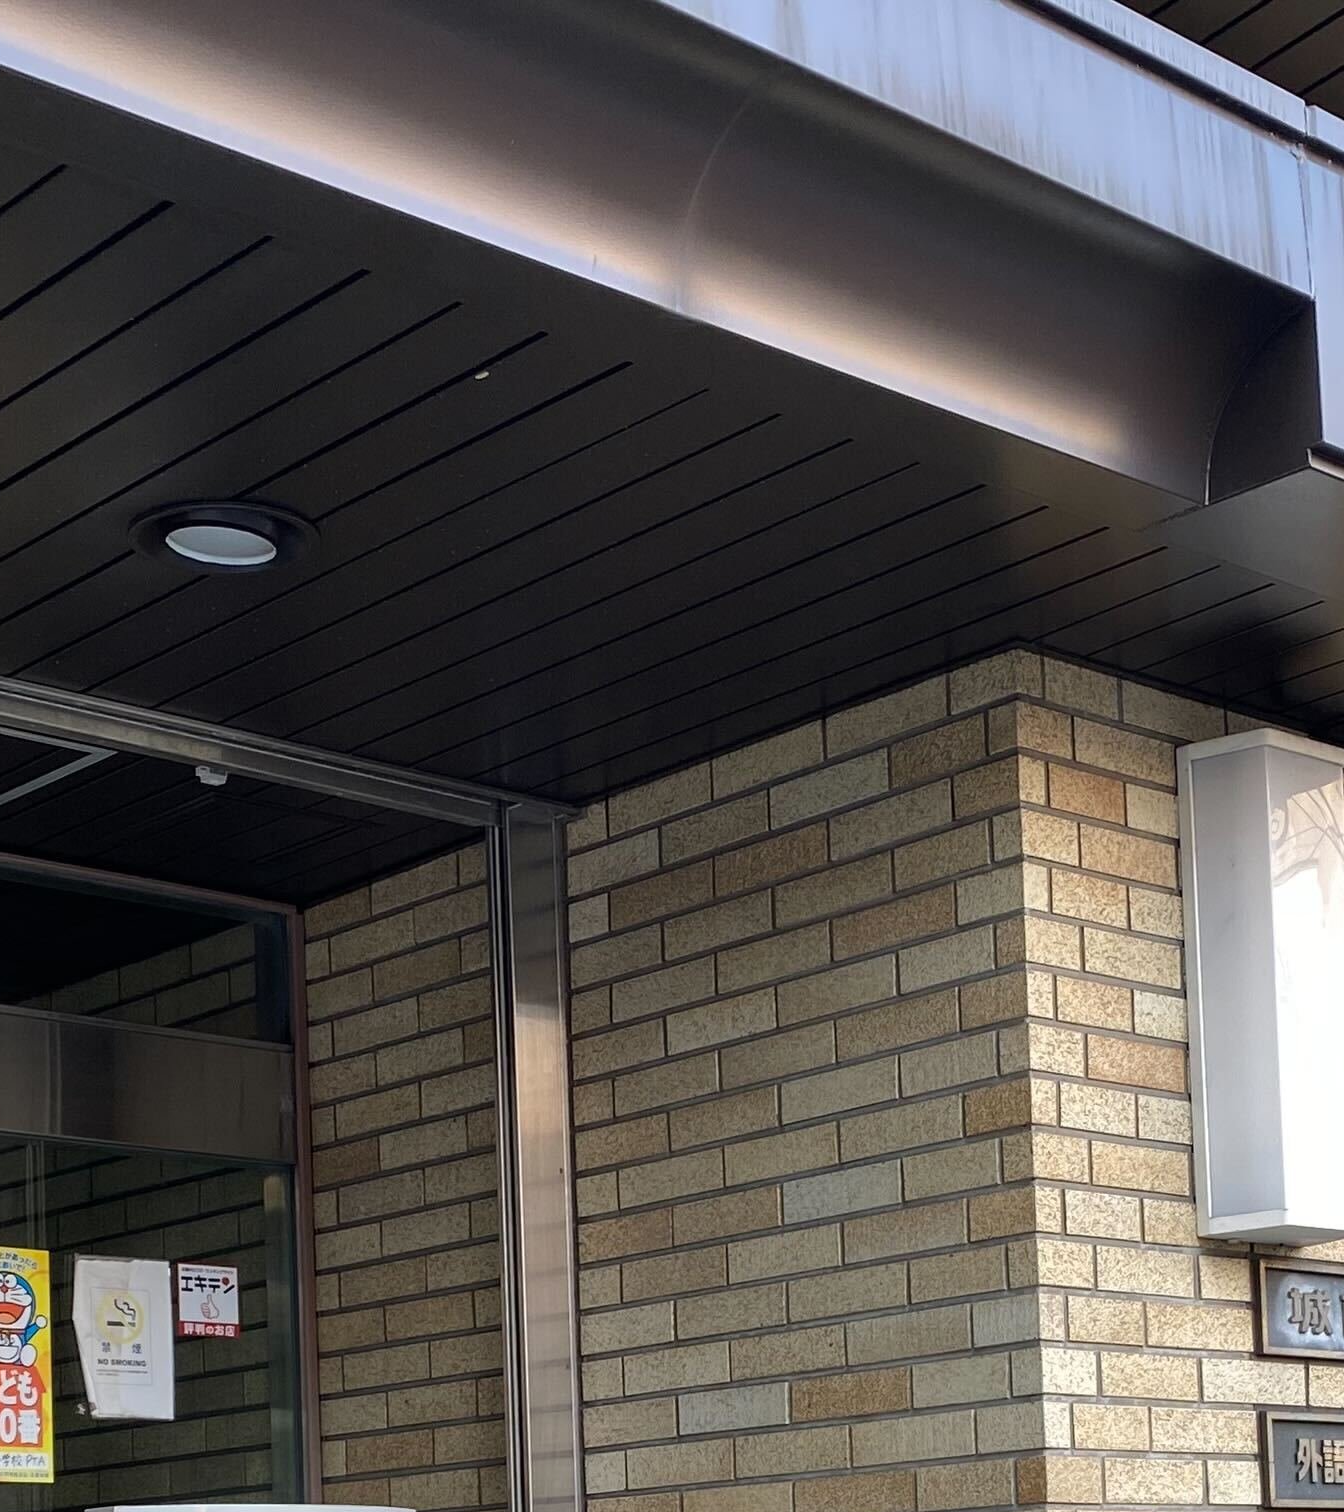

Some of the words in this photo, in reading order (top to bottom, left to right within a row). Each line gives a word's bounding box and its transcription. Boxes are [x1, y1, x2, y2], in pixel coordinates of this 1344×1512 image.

[181, 1275, 235, 1294] エキテン
[184, 1323, 235, 1337] 評判のお店
